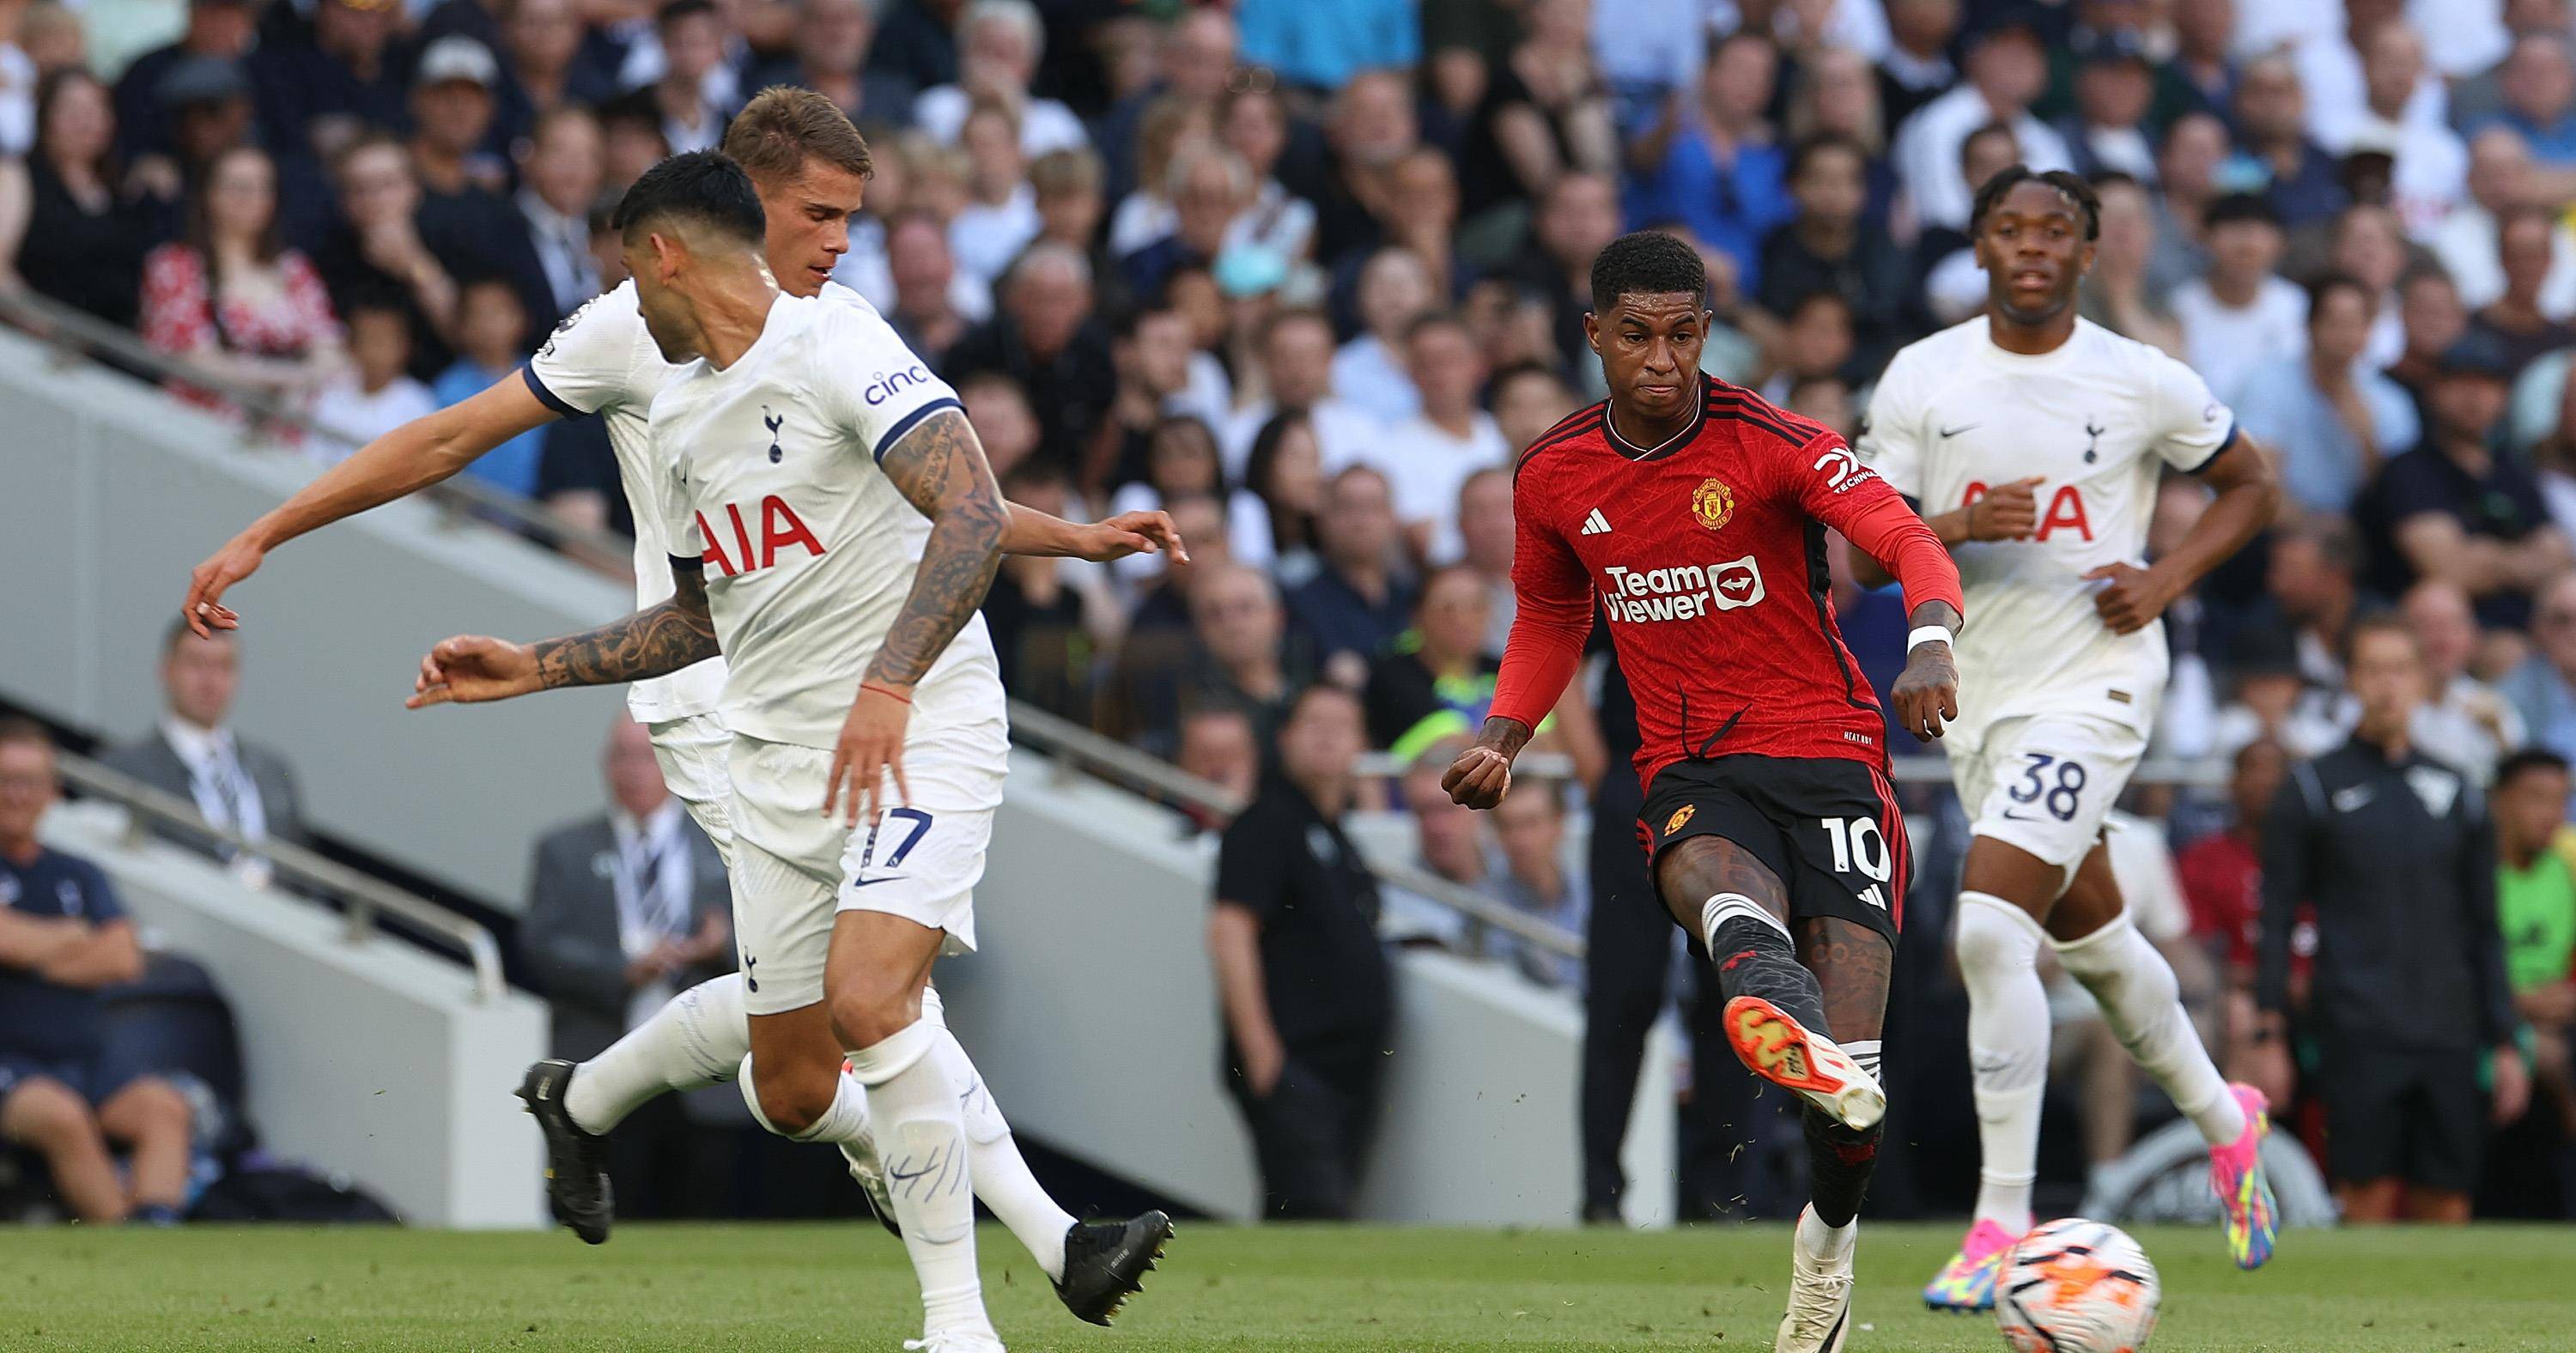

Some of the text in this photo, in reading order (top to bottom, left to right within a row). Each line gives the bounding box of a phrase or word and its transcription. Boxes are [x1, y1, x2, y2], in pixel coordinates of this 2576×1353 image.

[865, 366, 928, 406] cinc
[695, 494, 827, 577] AIA
[1703, 516, 1728, 526] UNITED
[1601, 591, 1710, 622] Viewer
[1604, 566, 1707, 597] Team
[2010, 754, 2087, 822] 38
[860, 807, 934, 868] 17
[1821, 816, 1892, 883] 10
